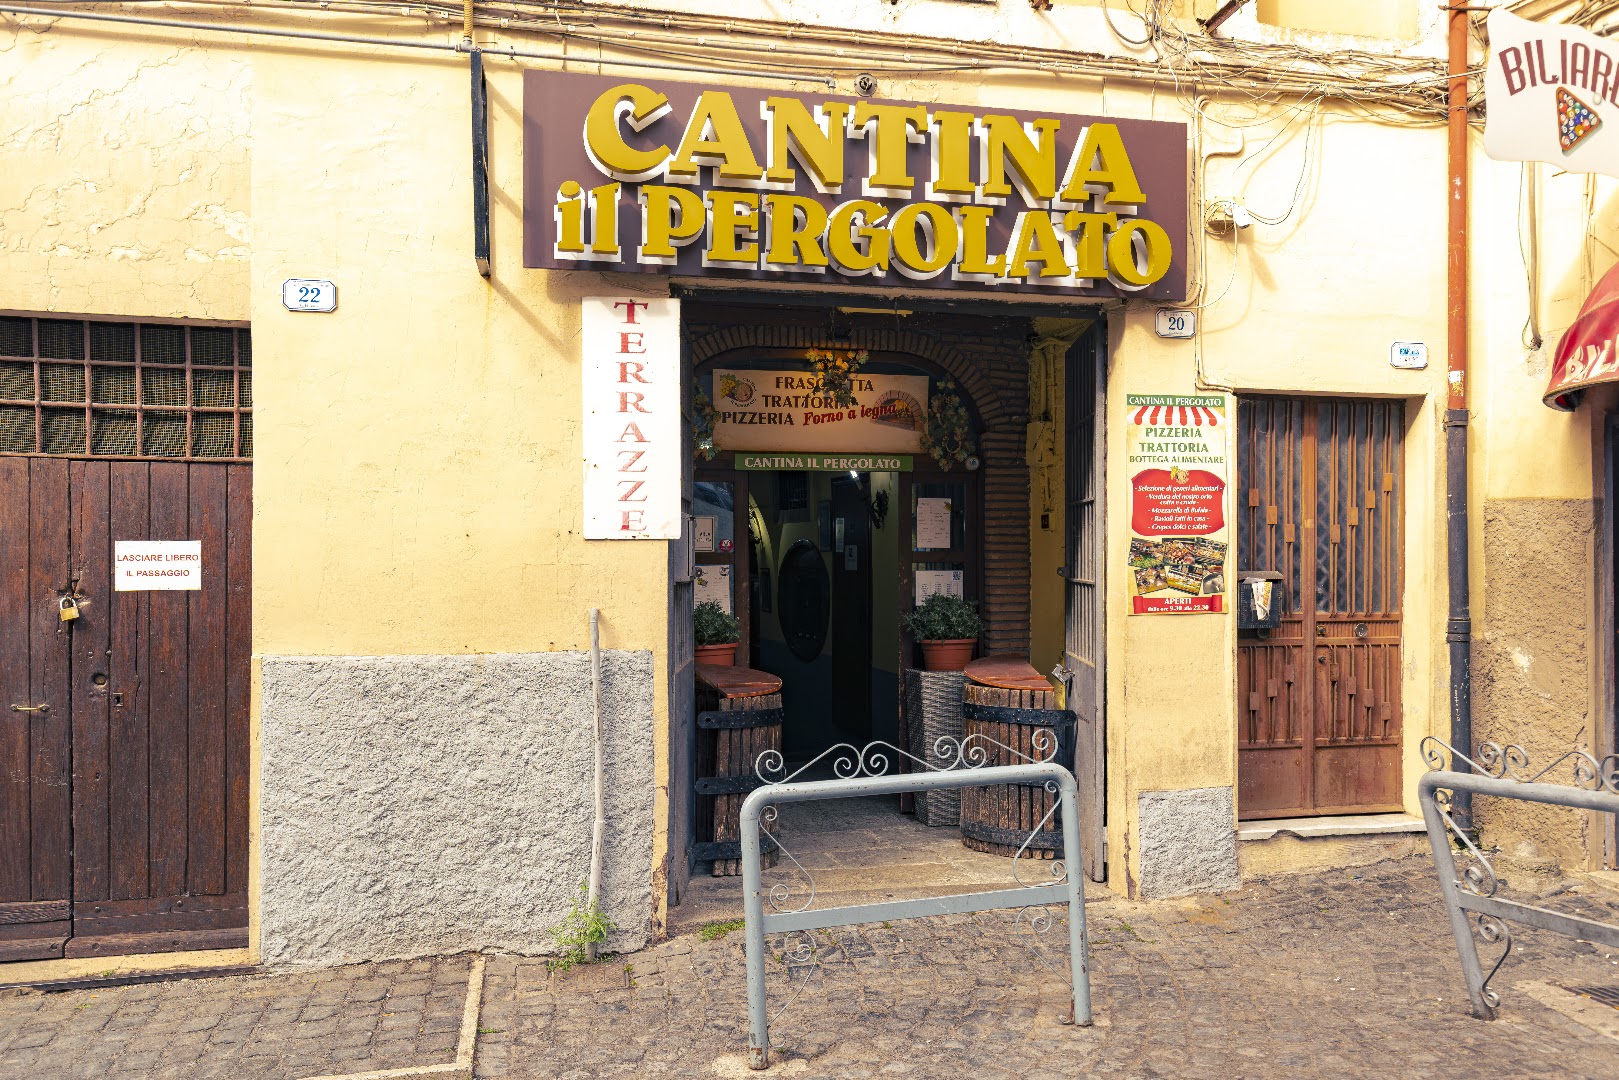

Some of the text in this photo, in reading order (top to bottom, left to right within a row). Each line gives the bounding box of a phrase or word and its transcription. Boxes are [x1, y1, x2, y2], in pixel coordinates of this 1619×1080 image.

[583, 84, 1146, 214] CANTINA
[554, 180, 1172, 291] il PERGOLATO
[298, 286, 321, 303] 22
[1168, 316, 1185, 331] 20
[775, 376, 875, 391] FRASCTTA
[1129, 396, 1222, 406] CANTINA IL PERGOLATO
[613, 302, 652, 531] TERRAZZE
[721, 404, 897, 426] PIZZERIA Forno a legna
[1145, 427, 1203, 438] PIZZERIA
[1139, 442, 1209, 453] TRATTORIA
[744, 456, 901, 469] CANTINA IL PERGOLATO
[1129, 455, 1224, 464] BOTTEGA ALIMENTARE
[117, 554, 199, 562] LASCIARE LIBERO
[136, 569, 190, 577] PASSAGGIO
